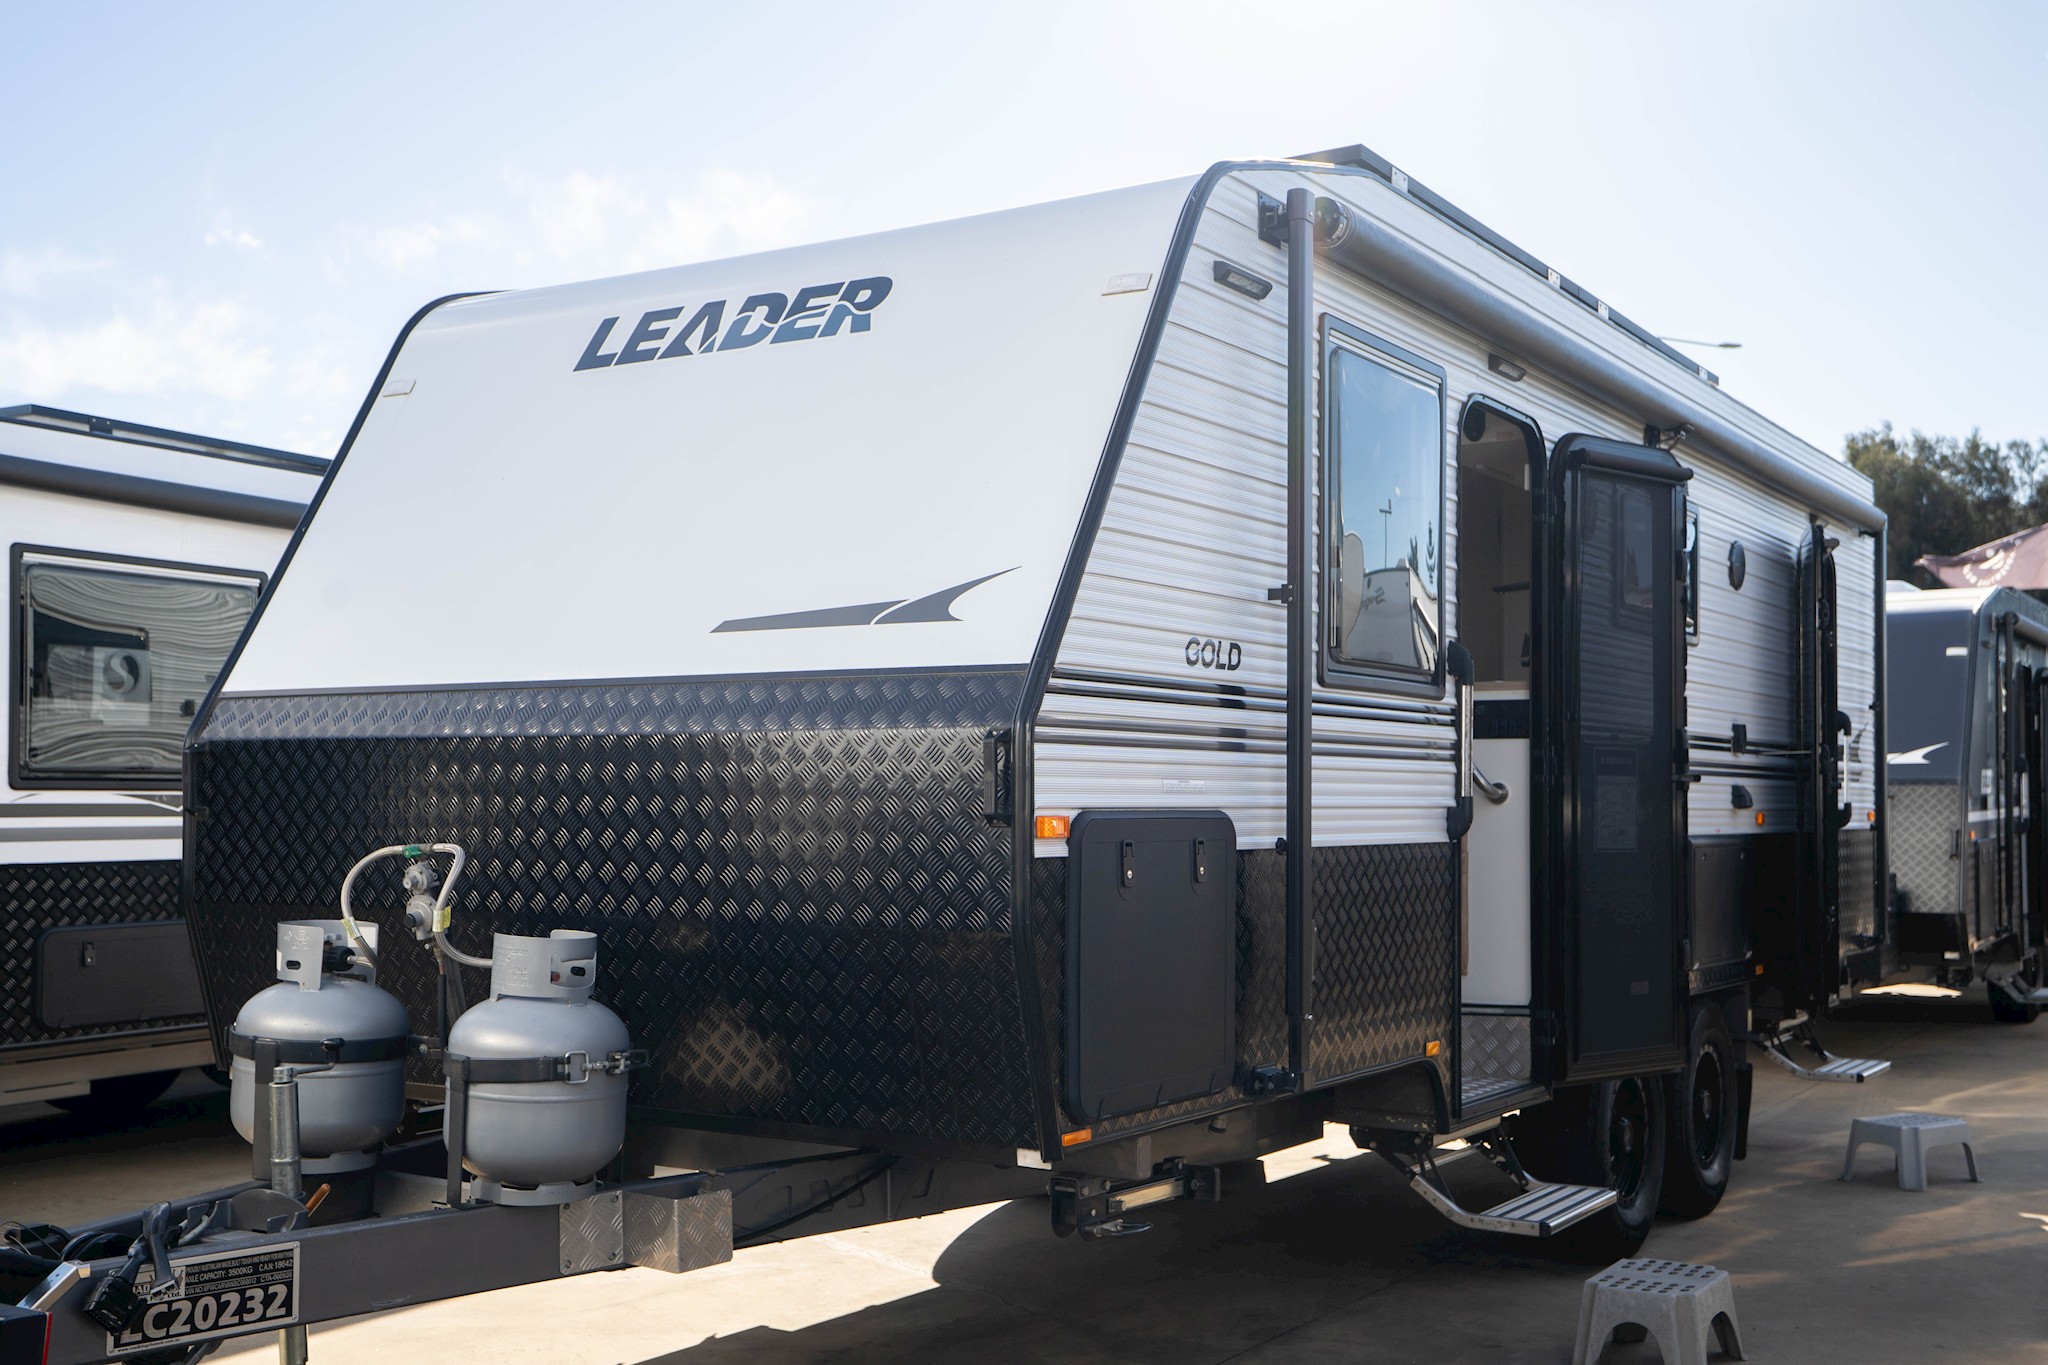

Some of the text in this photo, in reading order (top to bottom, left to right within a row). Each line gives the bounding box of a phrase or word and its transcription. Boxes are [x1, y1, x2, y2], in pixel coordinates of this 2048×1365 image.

[573, 276, 893, 372] LEADER
[1185, 637, 1242, 671] GOLD
[186, 1274, 199, 1283] AXLE
[200, 1270, 226, 1281] CAPACITY:
[228, 1265, 253, 1277] 3500KG
